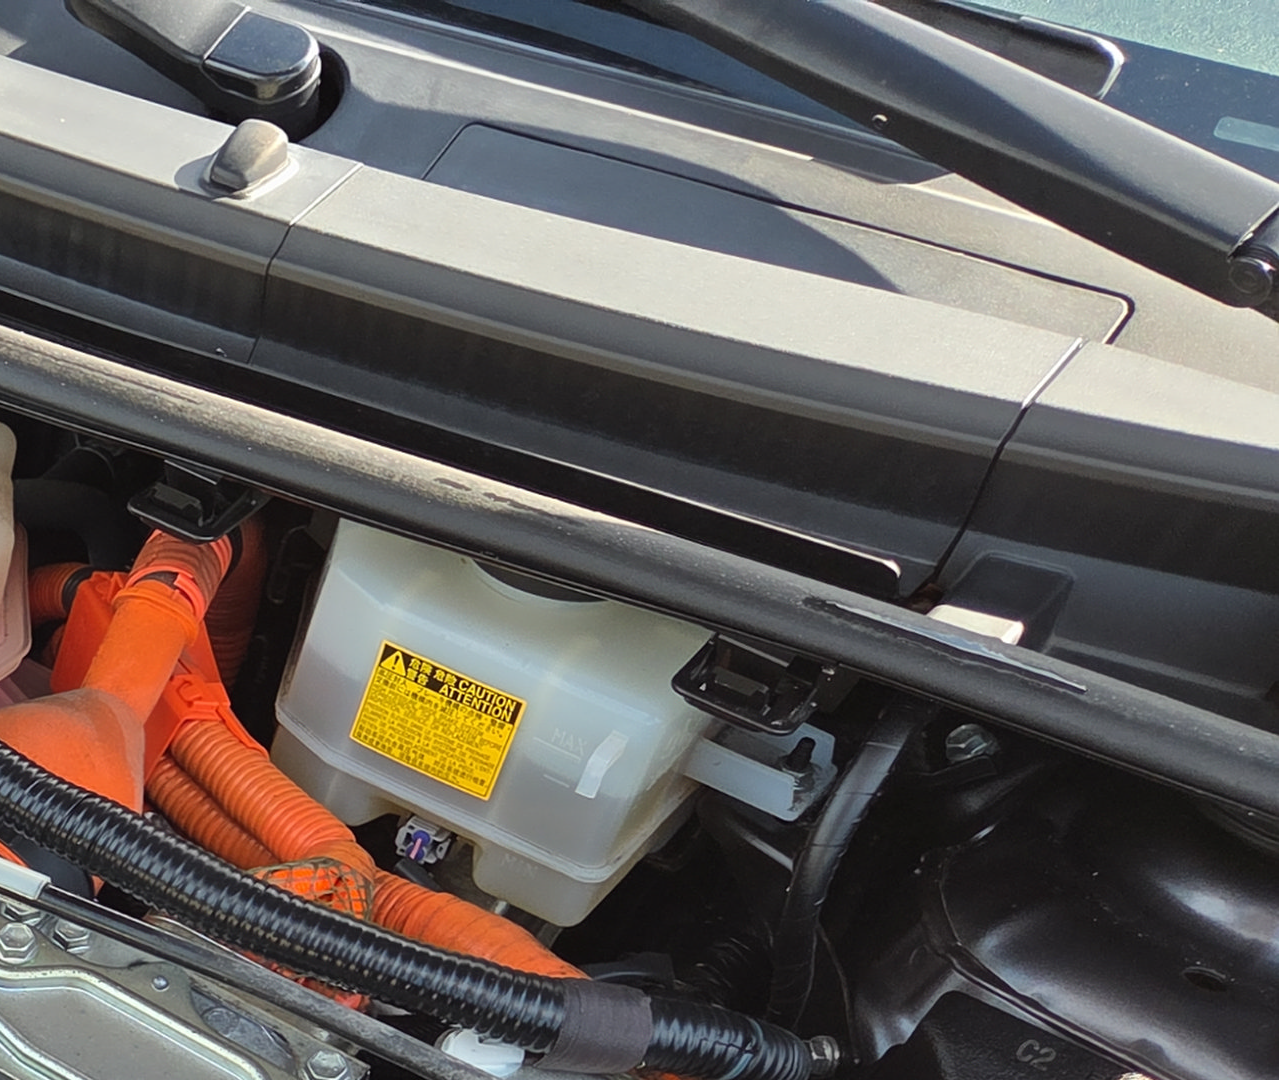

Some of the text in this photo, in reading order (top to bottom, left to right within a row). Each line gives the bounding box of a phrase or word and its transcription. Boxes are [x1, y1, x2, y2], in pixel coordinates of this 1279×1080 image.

[437, 681, 513, 724] ATTENTION
[456, 677, 517, 713] CAUTION
[551, 728, 587, 757] MAX
[1016, 1039, 1057, 1071] C2
